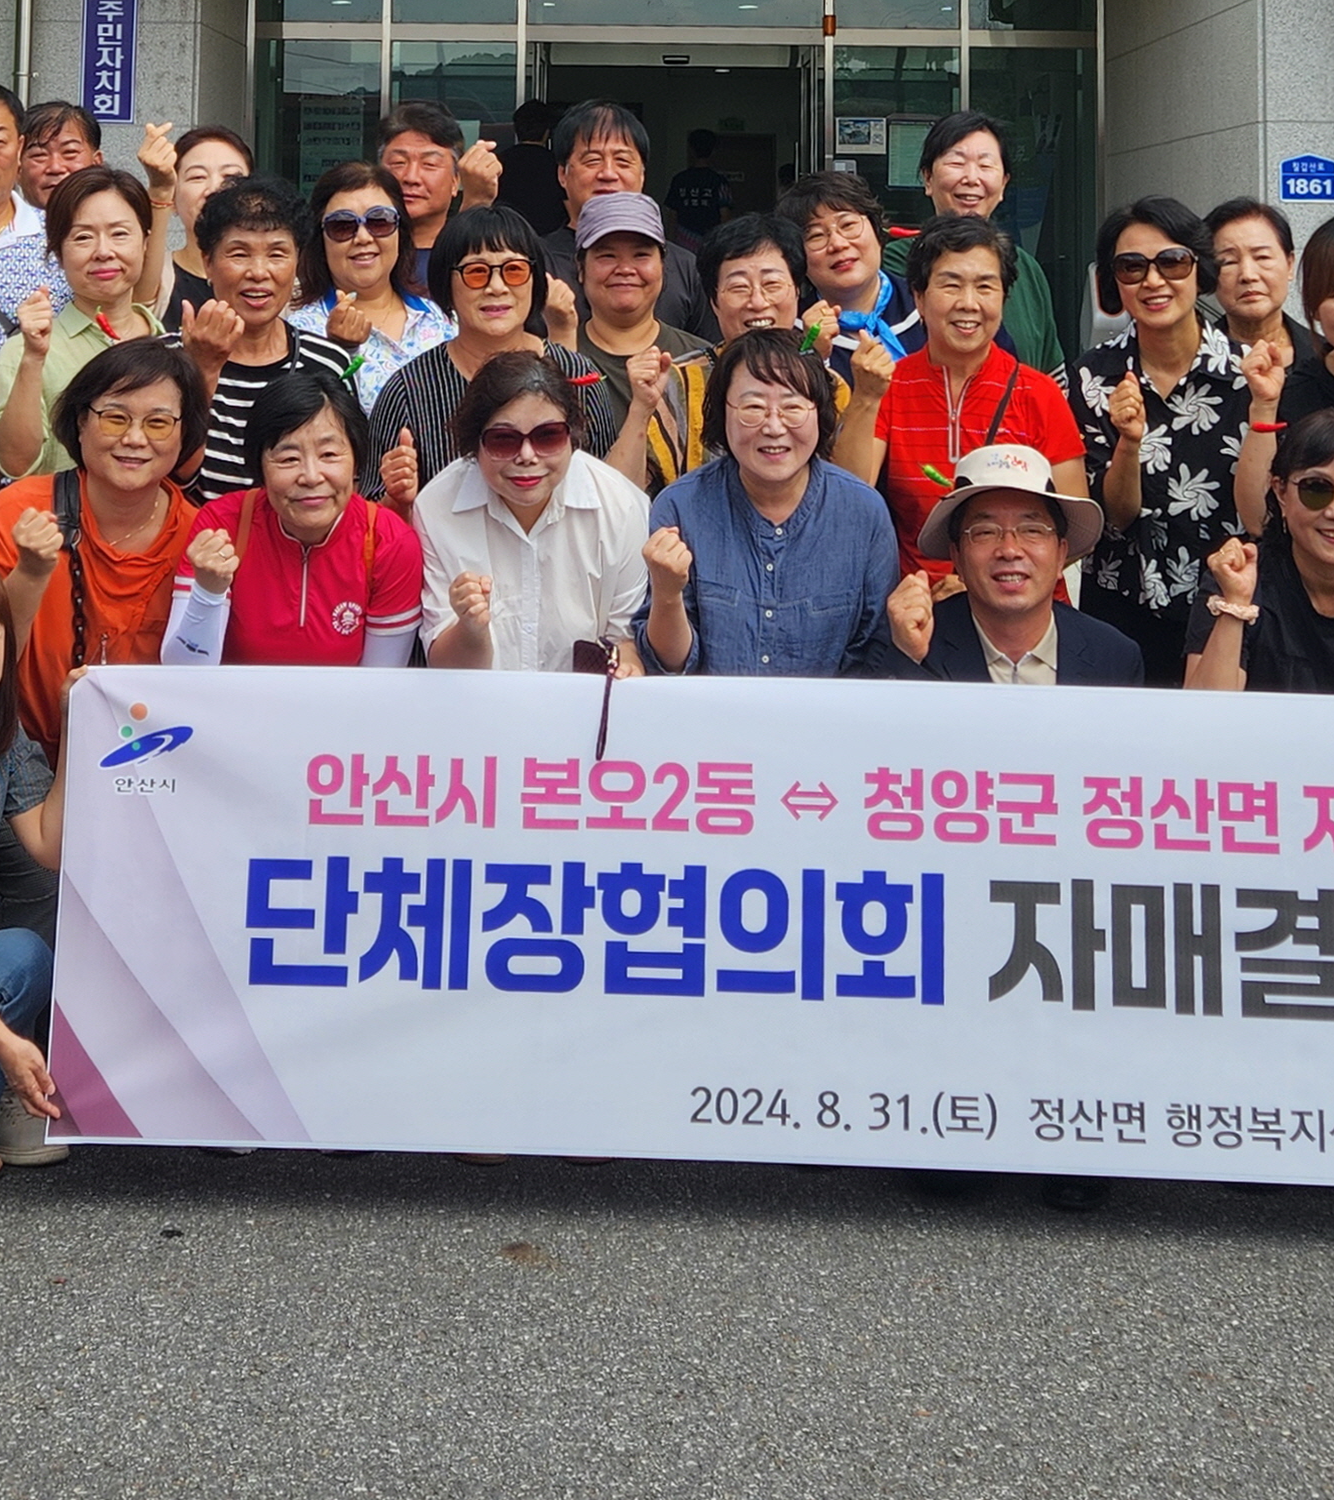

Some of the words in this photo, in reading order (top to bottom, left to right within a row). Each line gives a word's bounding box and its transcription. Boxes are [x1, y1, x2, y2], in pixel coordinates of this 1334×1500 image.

[93, 0, 125, 116] 주민자치회
[1285, 177, 1333, 196] 1861
[114, 777, 177, 794] 안산시
[306, 753, 498, 829] 안산시
[519, 756, 757, 836] 본오2동
[863, 766, 1059, 847] 청양군
[1082, 775, 1281, 855] 정산면
[244, 855, 946, 1006] 단체장협의회
[689, 1086, 802, 1130] 2024.
[815, 1090, 853, 1132] 8.
[868, 1091, 999, 1141] 31.(토)
[1027, 1097, 1148, 1146] 정산면
